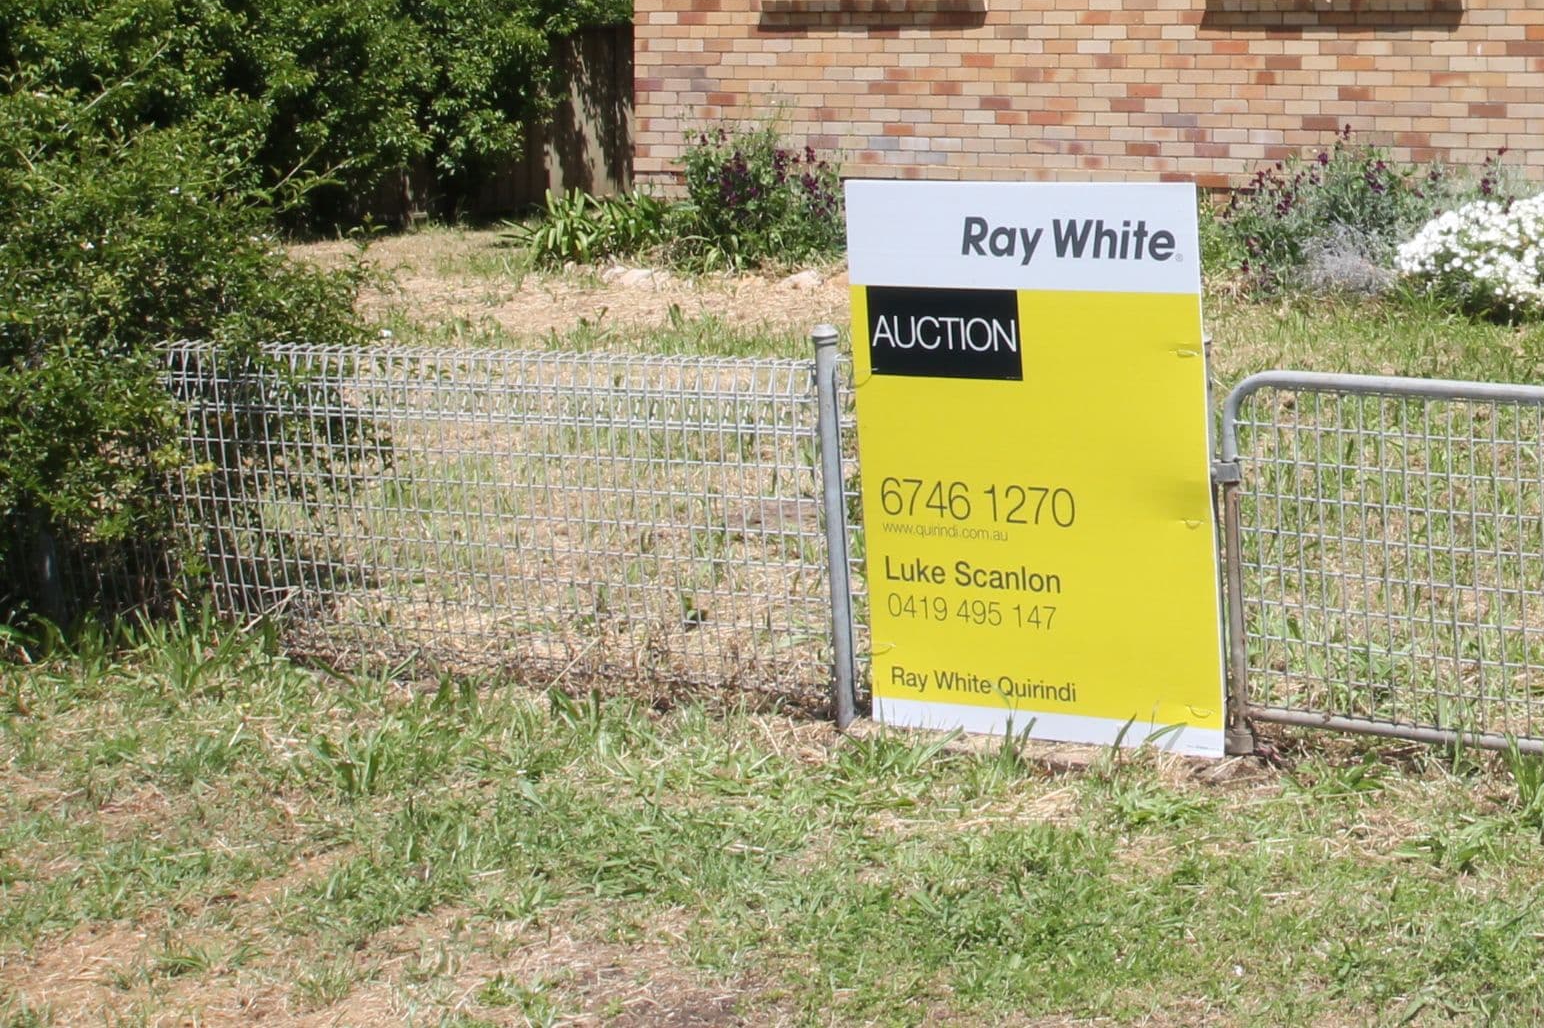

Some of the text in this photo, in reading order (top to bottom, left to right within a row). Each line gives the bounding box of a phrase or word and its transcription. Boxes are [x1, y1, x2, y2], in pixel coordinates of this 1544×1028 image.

[961, 216, 1175, 265] Ray White
[872, 315, 1017, 352] AUCTION
[881, 477, 1076, 528] 6746 1270
[883, 522, 1008, 541] www.quirindi.com.au
[885, 555, 1061, 594] Luke Scanlon
[888, 593, 1056, 630] 0419 495 147
[891, 666, 1076, 702] Ray White Quirindi
